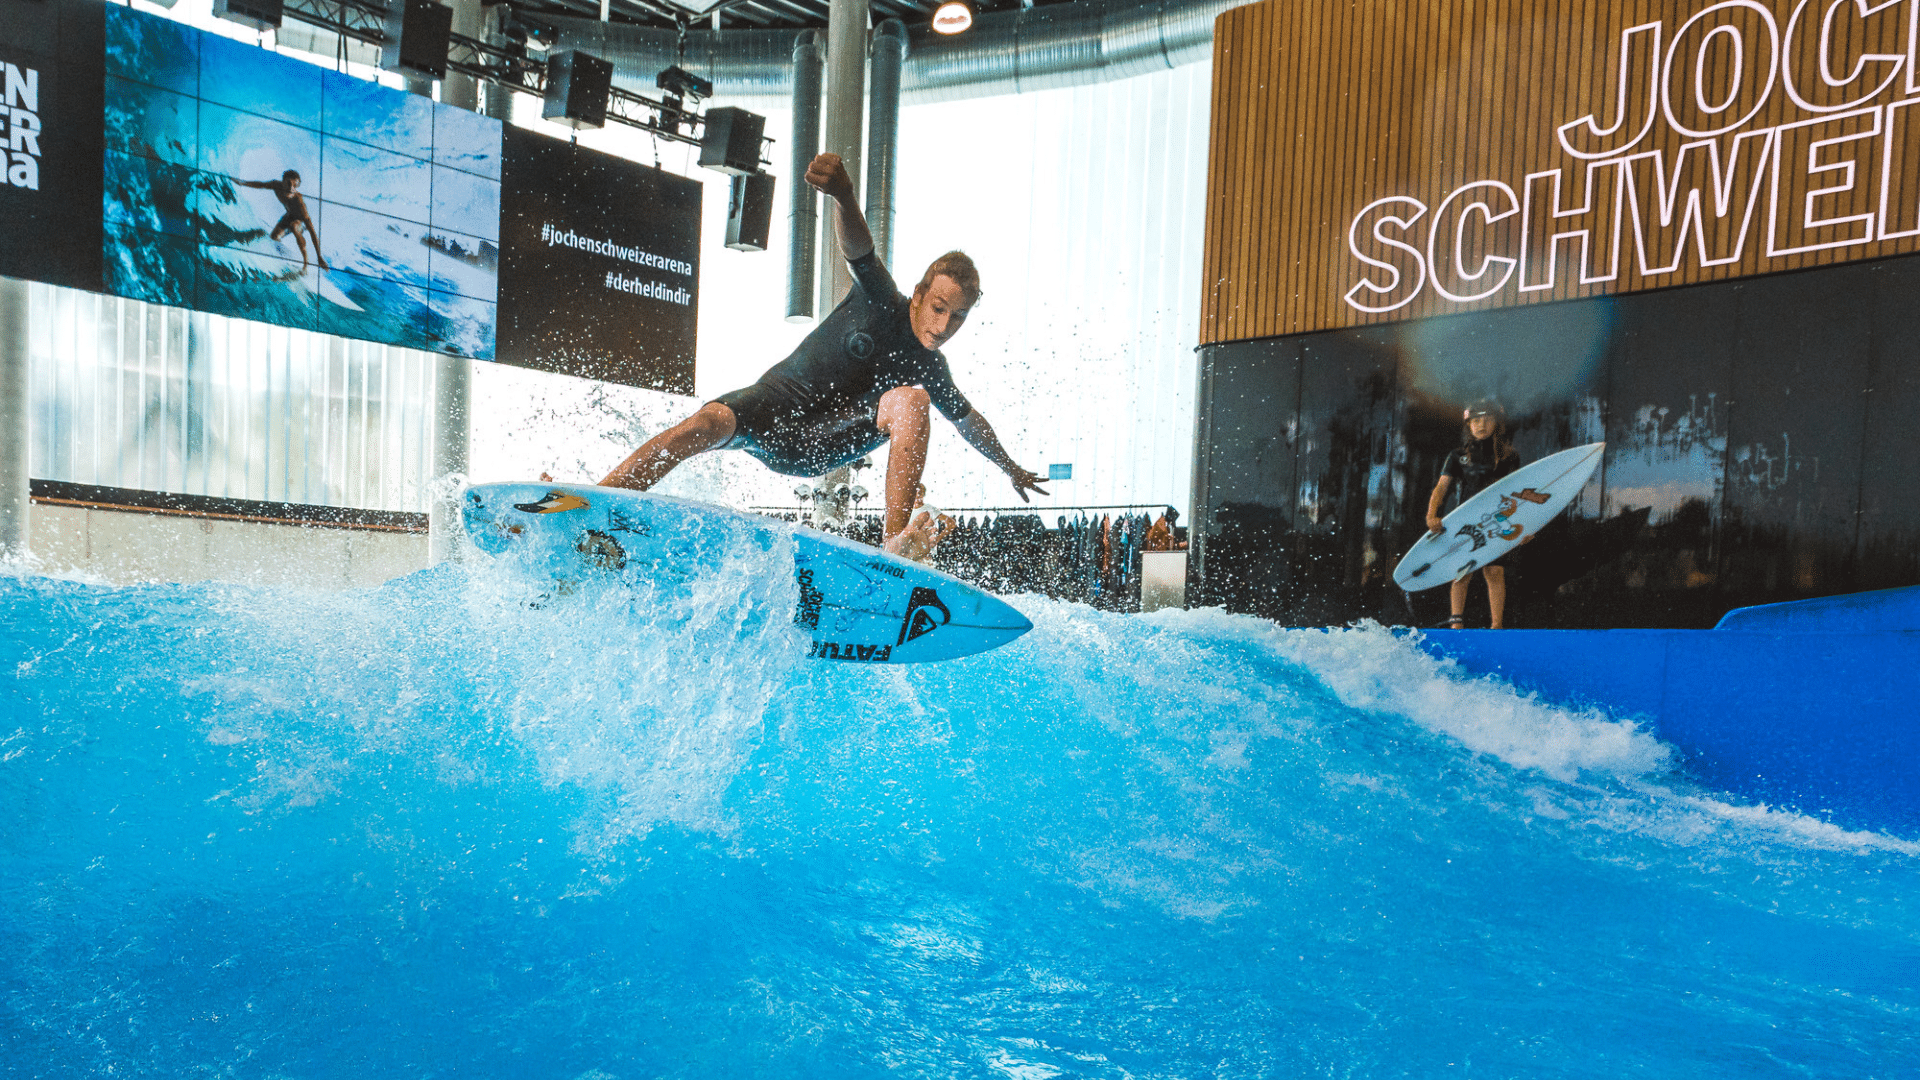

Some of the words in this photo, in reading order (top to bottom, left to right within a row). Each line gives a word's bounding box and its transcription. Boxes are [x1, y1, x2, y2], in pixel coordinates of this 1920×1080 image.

[0, 61, 38, 113] N
[1558, 0, 1920, 160] JOC
[541, 223, 692, 276] #jochenschweizerarena
[605, 271, 691, 306] #derheldindir
